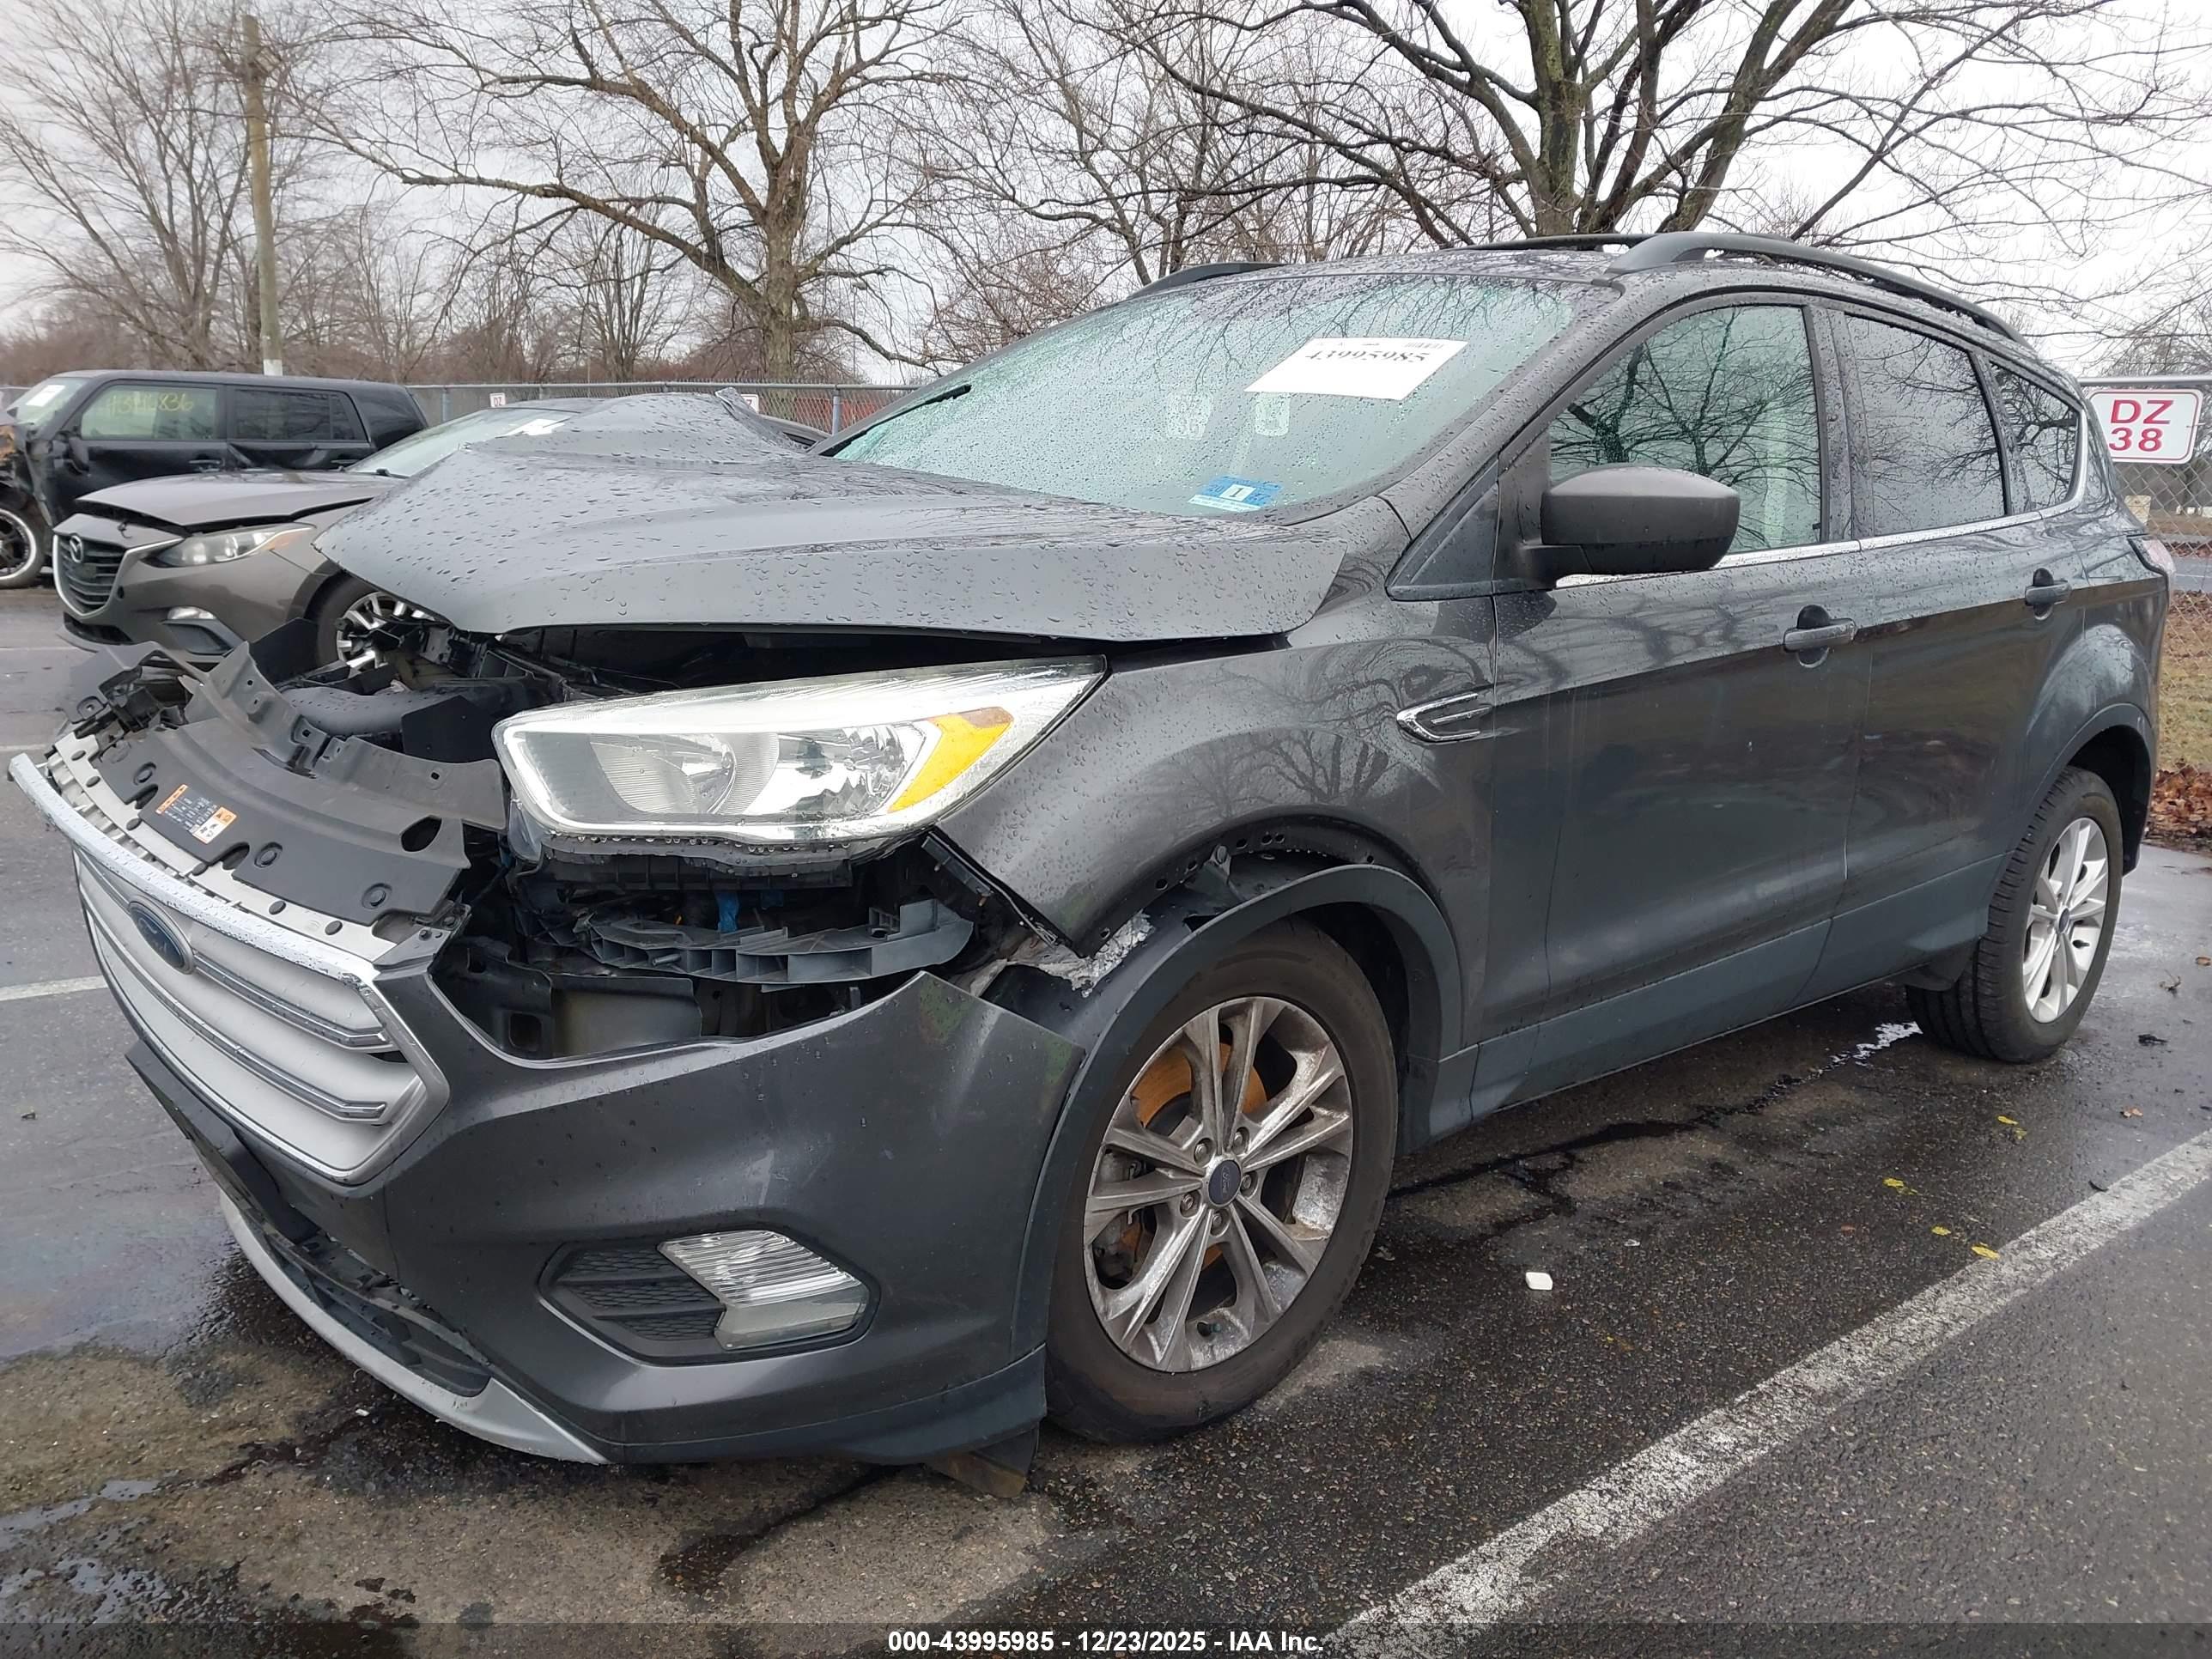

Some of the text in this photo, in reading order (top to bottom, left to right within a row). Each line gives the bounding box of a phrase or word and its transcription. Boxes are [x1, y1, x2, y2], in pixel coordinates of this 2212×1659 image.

[2111, 399, 2174, 424] DZ
[2109, 427, 2163, 452] 38
[1230, 487, 1244, 498] 1
